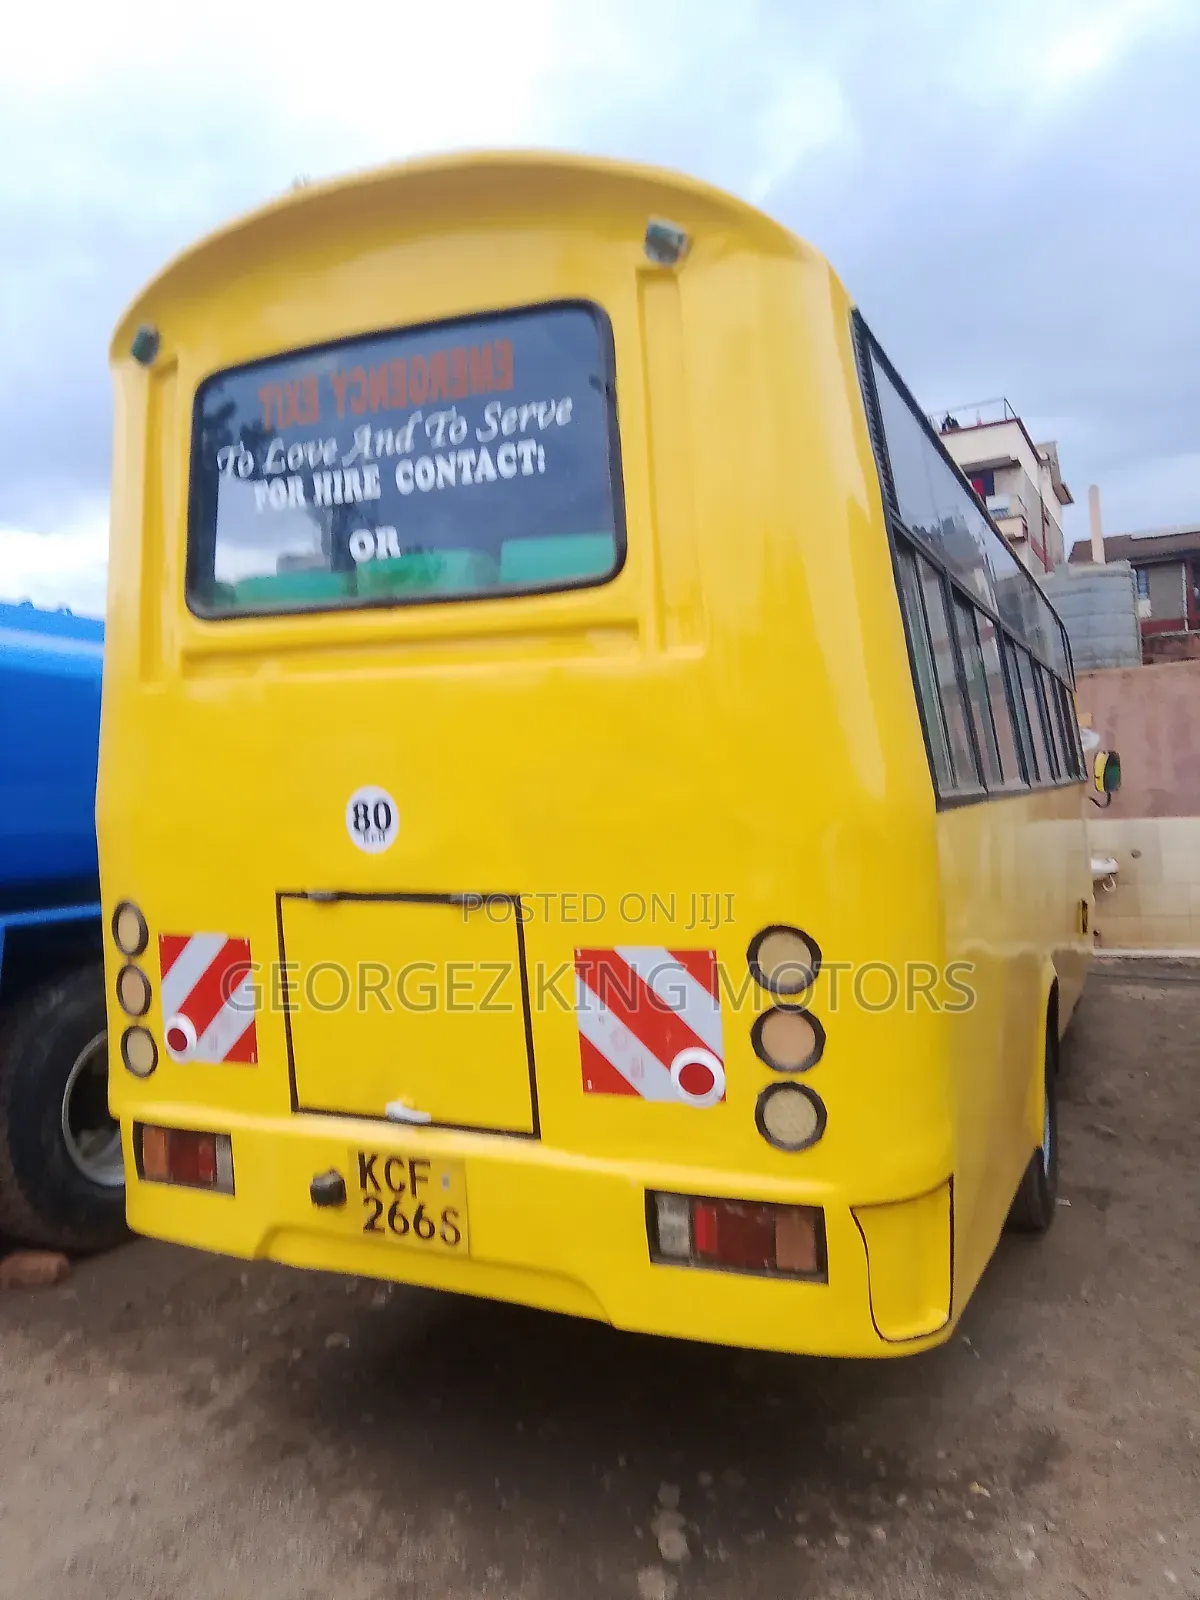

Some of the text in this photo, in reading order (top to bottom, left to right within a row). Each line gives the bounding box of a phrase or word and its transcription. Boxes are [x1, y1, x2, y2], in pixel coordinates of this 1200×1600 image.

[217, 396, 573, 479] To Love And To Serve
[313, 463, 382, 508] HIRE
[349, 526, 400, 563] OR
[352, 800, 392, 832] 80
[357, 1150, 431, 1198] KCF
[362, 1195, 461, 1246] 266S
